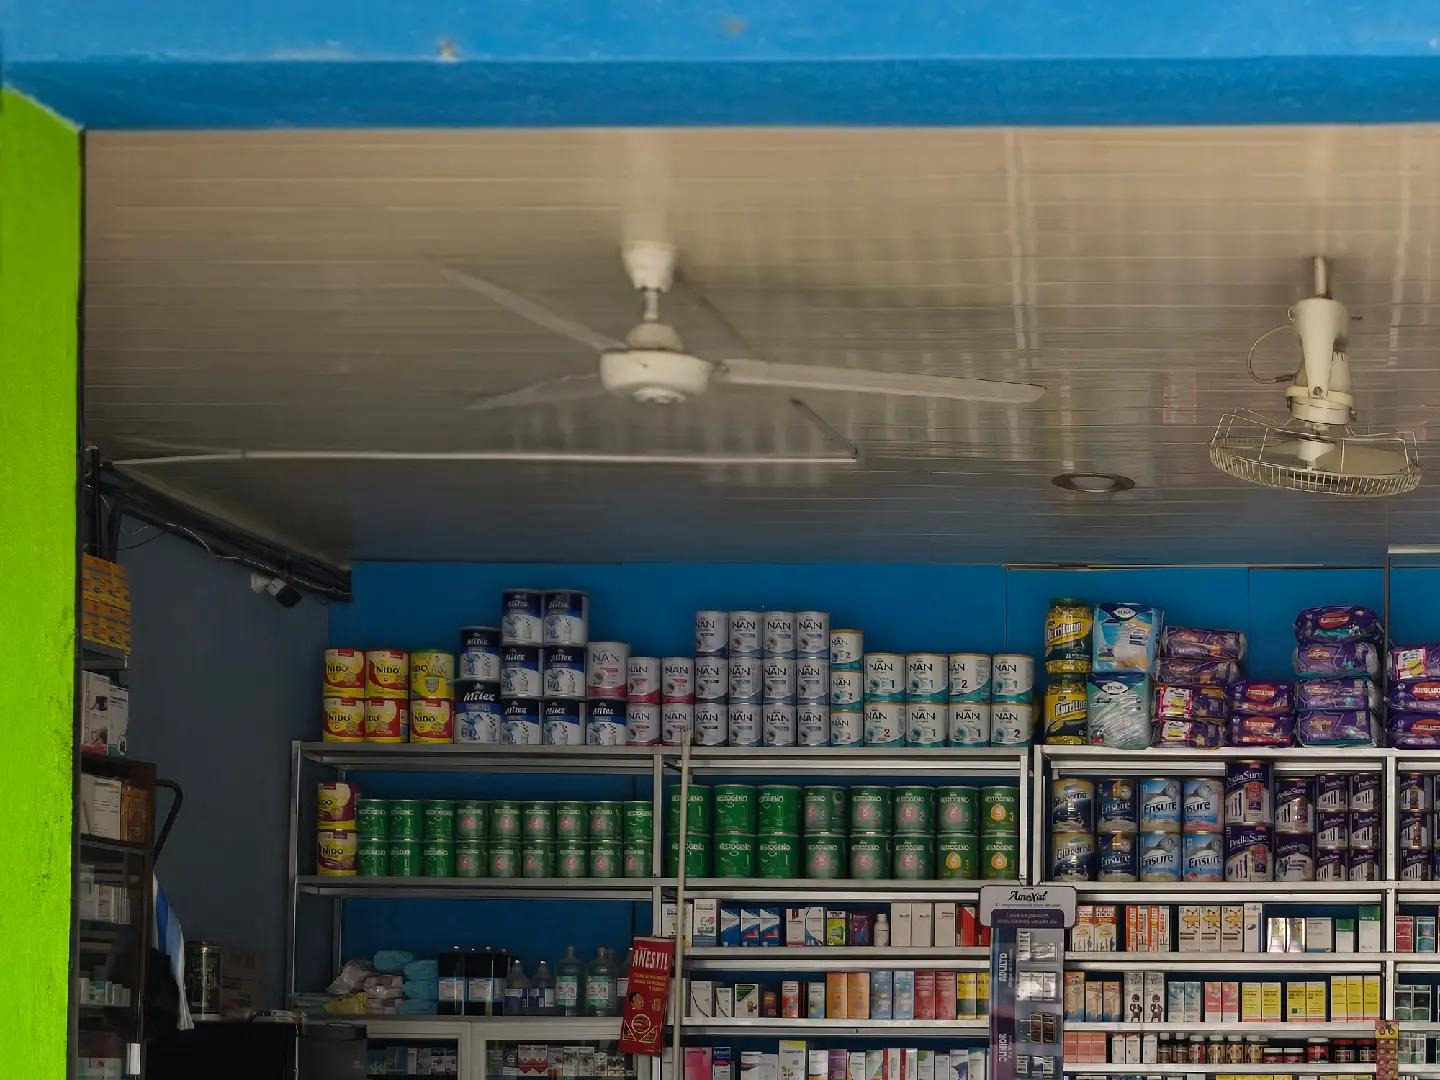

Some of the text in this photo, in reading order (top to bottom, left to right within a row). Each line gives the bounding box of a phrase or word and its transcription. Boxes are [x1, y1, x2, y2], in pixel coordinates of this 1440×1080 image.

[732, 621, 756, 629] NAN
[768, 621, 791, 630] NAN
[799, 621, 823, 630] NAN
[870, 663, 893, 671] NAN
[910, 663, 933, 672] NAN
[995, 664, 1017, 672] NAN
[665, 712, 687, 720] NAN
[730, 713, 753, 722] NAN
[767, 713, 790, 722] NAN
[799, 713, 822, 722] NAN
[912, 712, 936, 720] NAN
[956, 711, 980, 720] NAN
[995, 712, 1018, 721] NAN
[1144, 800, 1177, 814] Ensure
[1185, 801, 1211, 813] nsure
